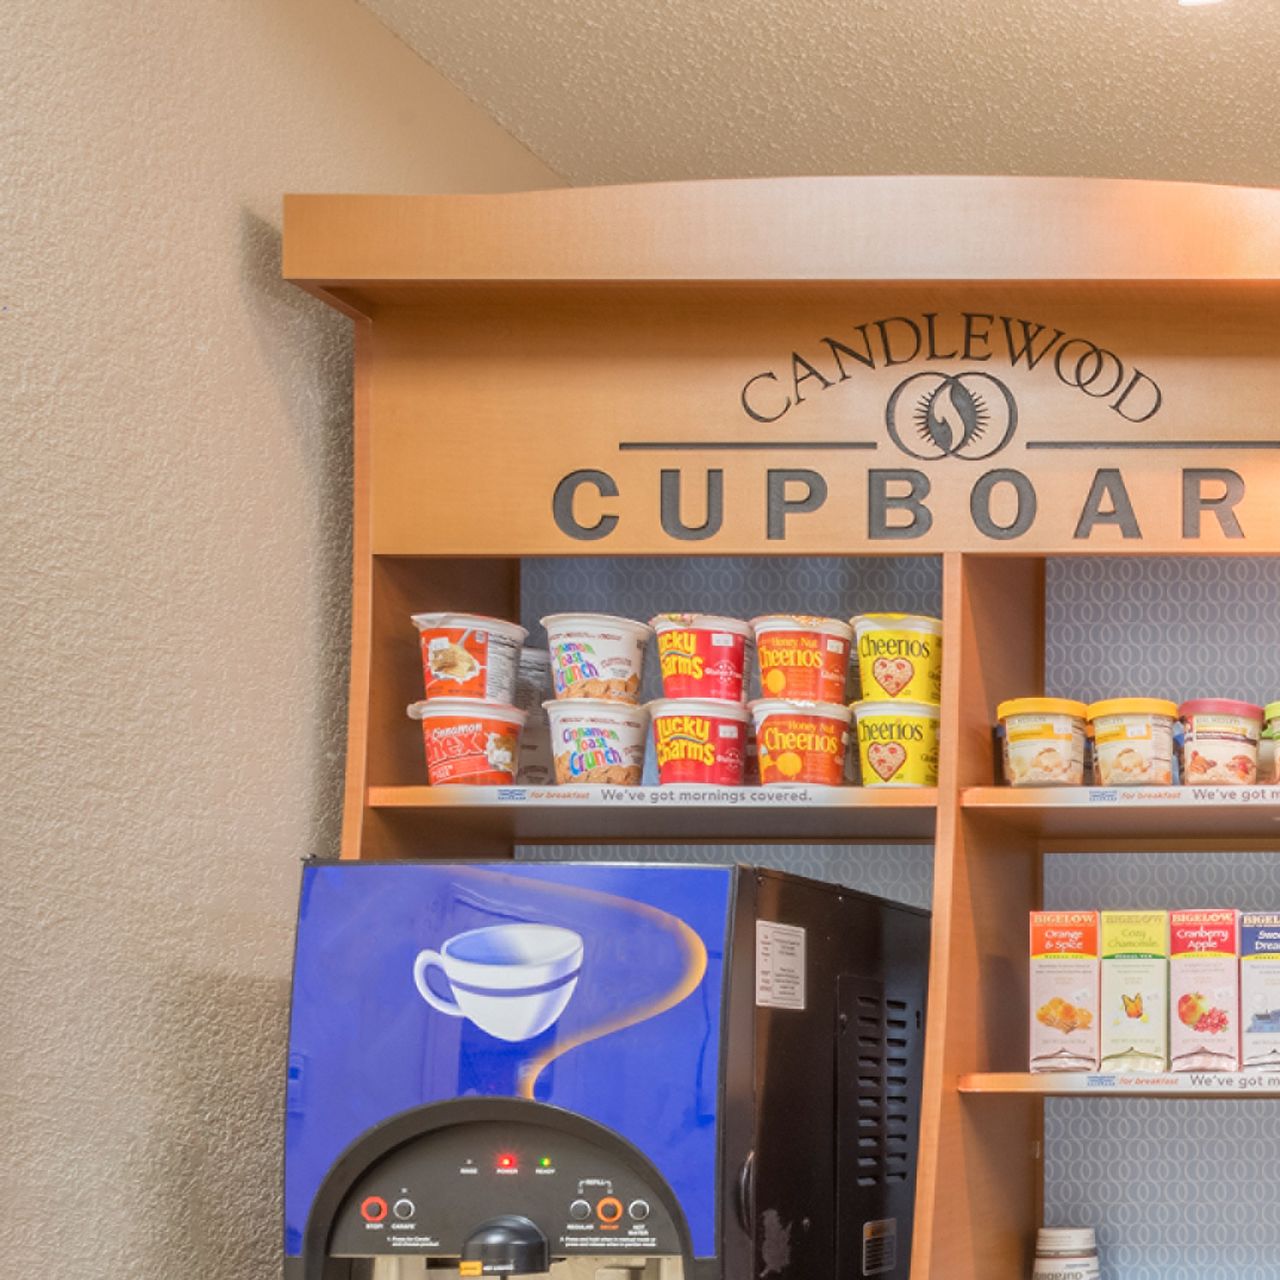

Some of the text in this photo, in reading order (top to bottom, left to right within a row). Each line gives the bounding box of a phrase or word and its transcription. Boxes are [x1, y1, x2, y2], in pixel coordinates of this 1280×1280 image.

[740, 312, 1162, 424] CANDLEWOOD
[861, 634, 930, 658] Cheerios
[657, 717, 711, 742] Lucky
[764, 726, 838, 754] Cheerios
[601, 788, 812, 806] We've got mornings covered.
[1192, 788, 1237, 801] We've
[1242, 789, 1267, 804] got
[1034, 914, 1094, 924] BIGELOW
[1172, 912, 1233, 923] BIGELOW
[1045, 929, 1083, 942] Orange
[1177, 926, 1229, 942] Cranberry
[1055, 939, 1083, 952] Spice
[1187, 939, 1218, 952] Apple
[1190, 1073, 1234, 1088] We've
[1239, 1076, 1263, 1091] got
